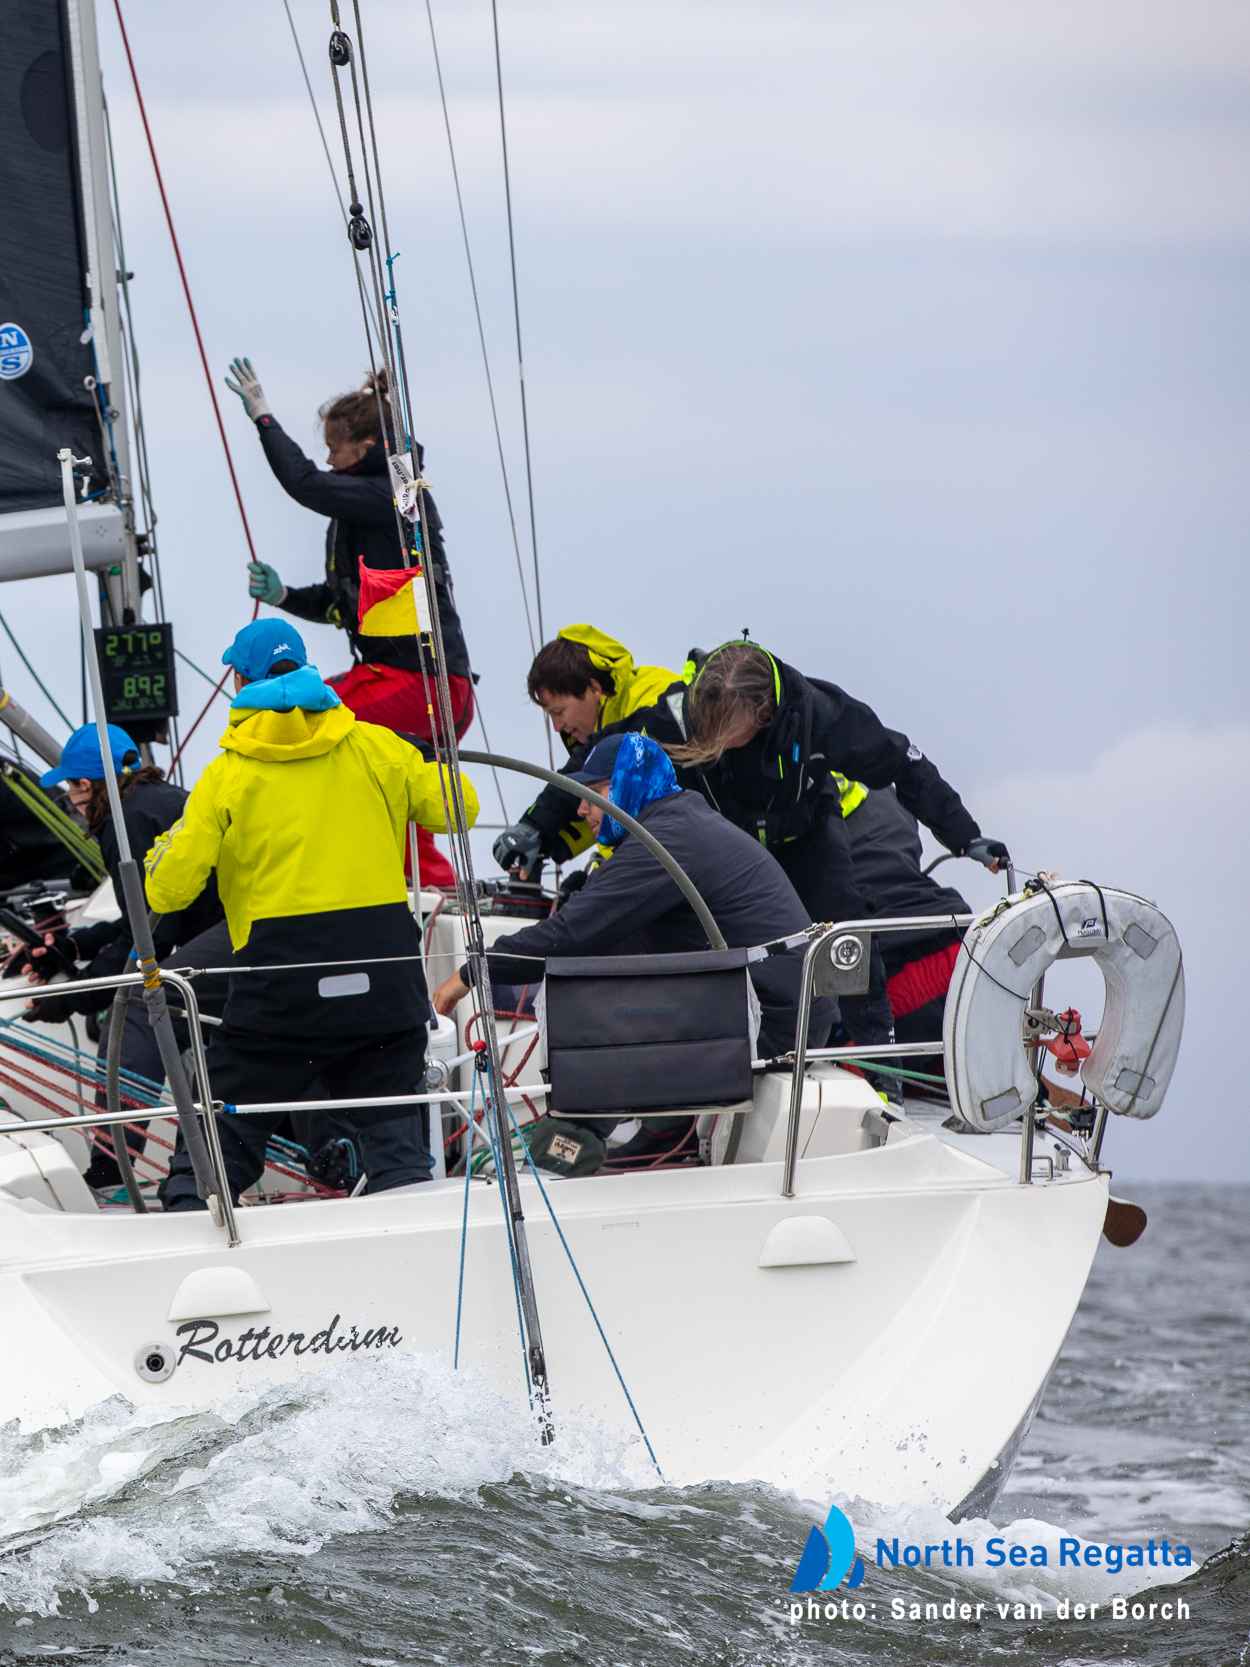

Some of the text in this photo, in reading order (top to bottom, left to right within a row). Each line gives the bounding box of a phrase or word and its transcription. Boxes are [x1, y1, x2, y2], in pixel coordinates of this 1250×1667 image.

[0, 331, 18, 348] N
[2, 356, 21, 371] S
[176, 1313, 403, 1366] Rotterdam
